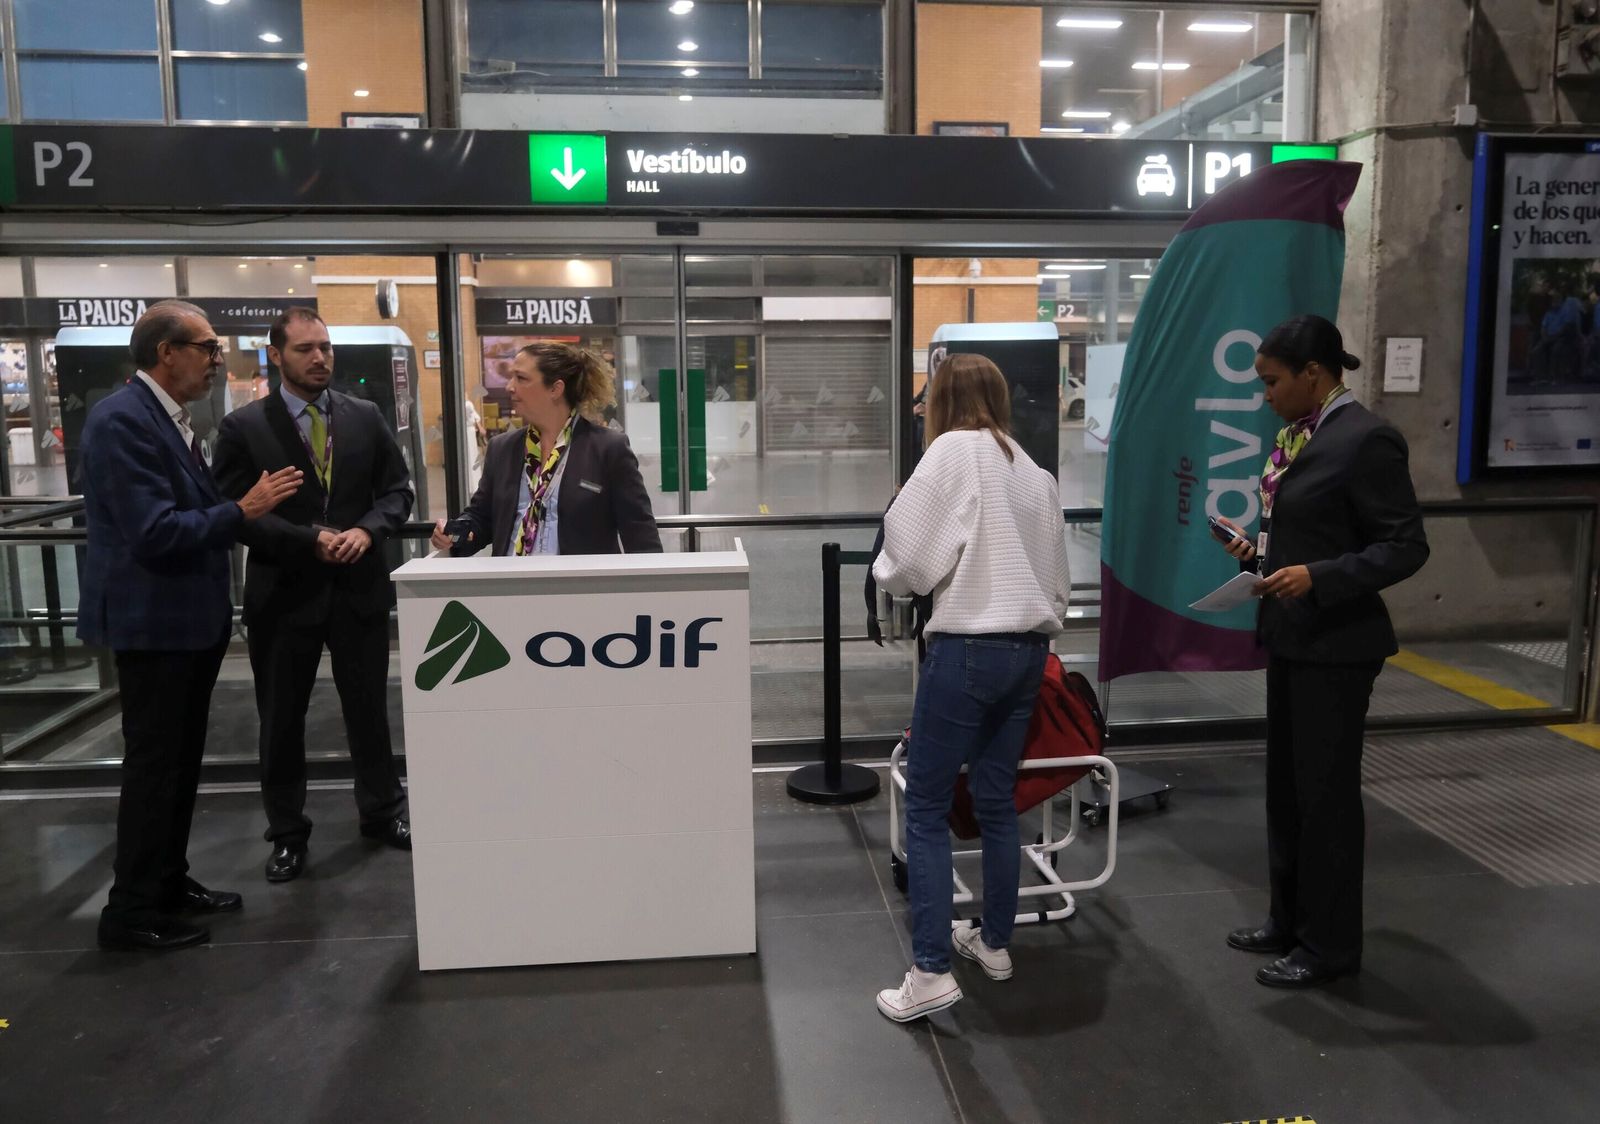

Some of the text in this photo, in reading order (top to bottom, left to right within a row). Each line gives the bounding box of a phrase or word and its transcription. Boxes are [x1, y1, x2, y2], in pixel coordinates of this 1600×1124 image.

[33, 141, 94, 187] P2
[626, 148, 747, 174] Vestíbulo
[1204, 151, 1252, 195] P1
[626, 180, 660, 193] HALL
[1515, 175, 1541, 196] La
[1513, 200, 1539, 220] de
[1540, 200, 1570, 220] los
[1512, 225, 1592, 250] y hacen.
[58, 304, 78, 321] LA
[227, 305, 283, 317] cafeteria
[506, 299, 594, 325] LA PAUSA
[1057, 304, 1075, 318] P2
[1194, 328, 1264, 530] avlo
[1172, 455, 1200, 527] renfe
[524, 614, 724, 669] adif
